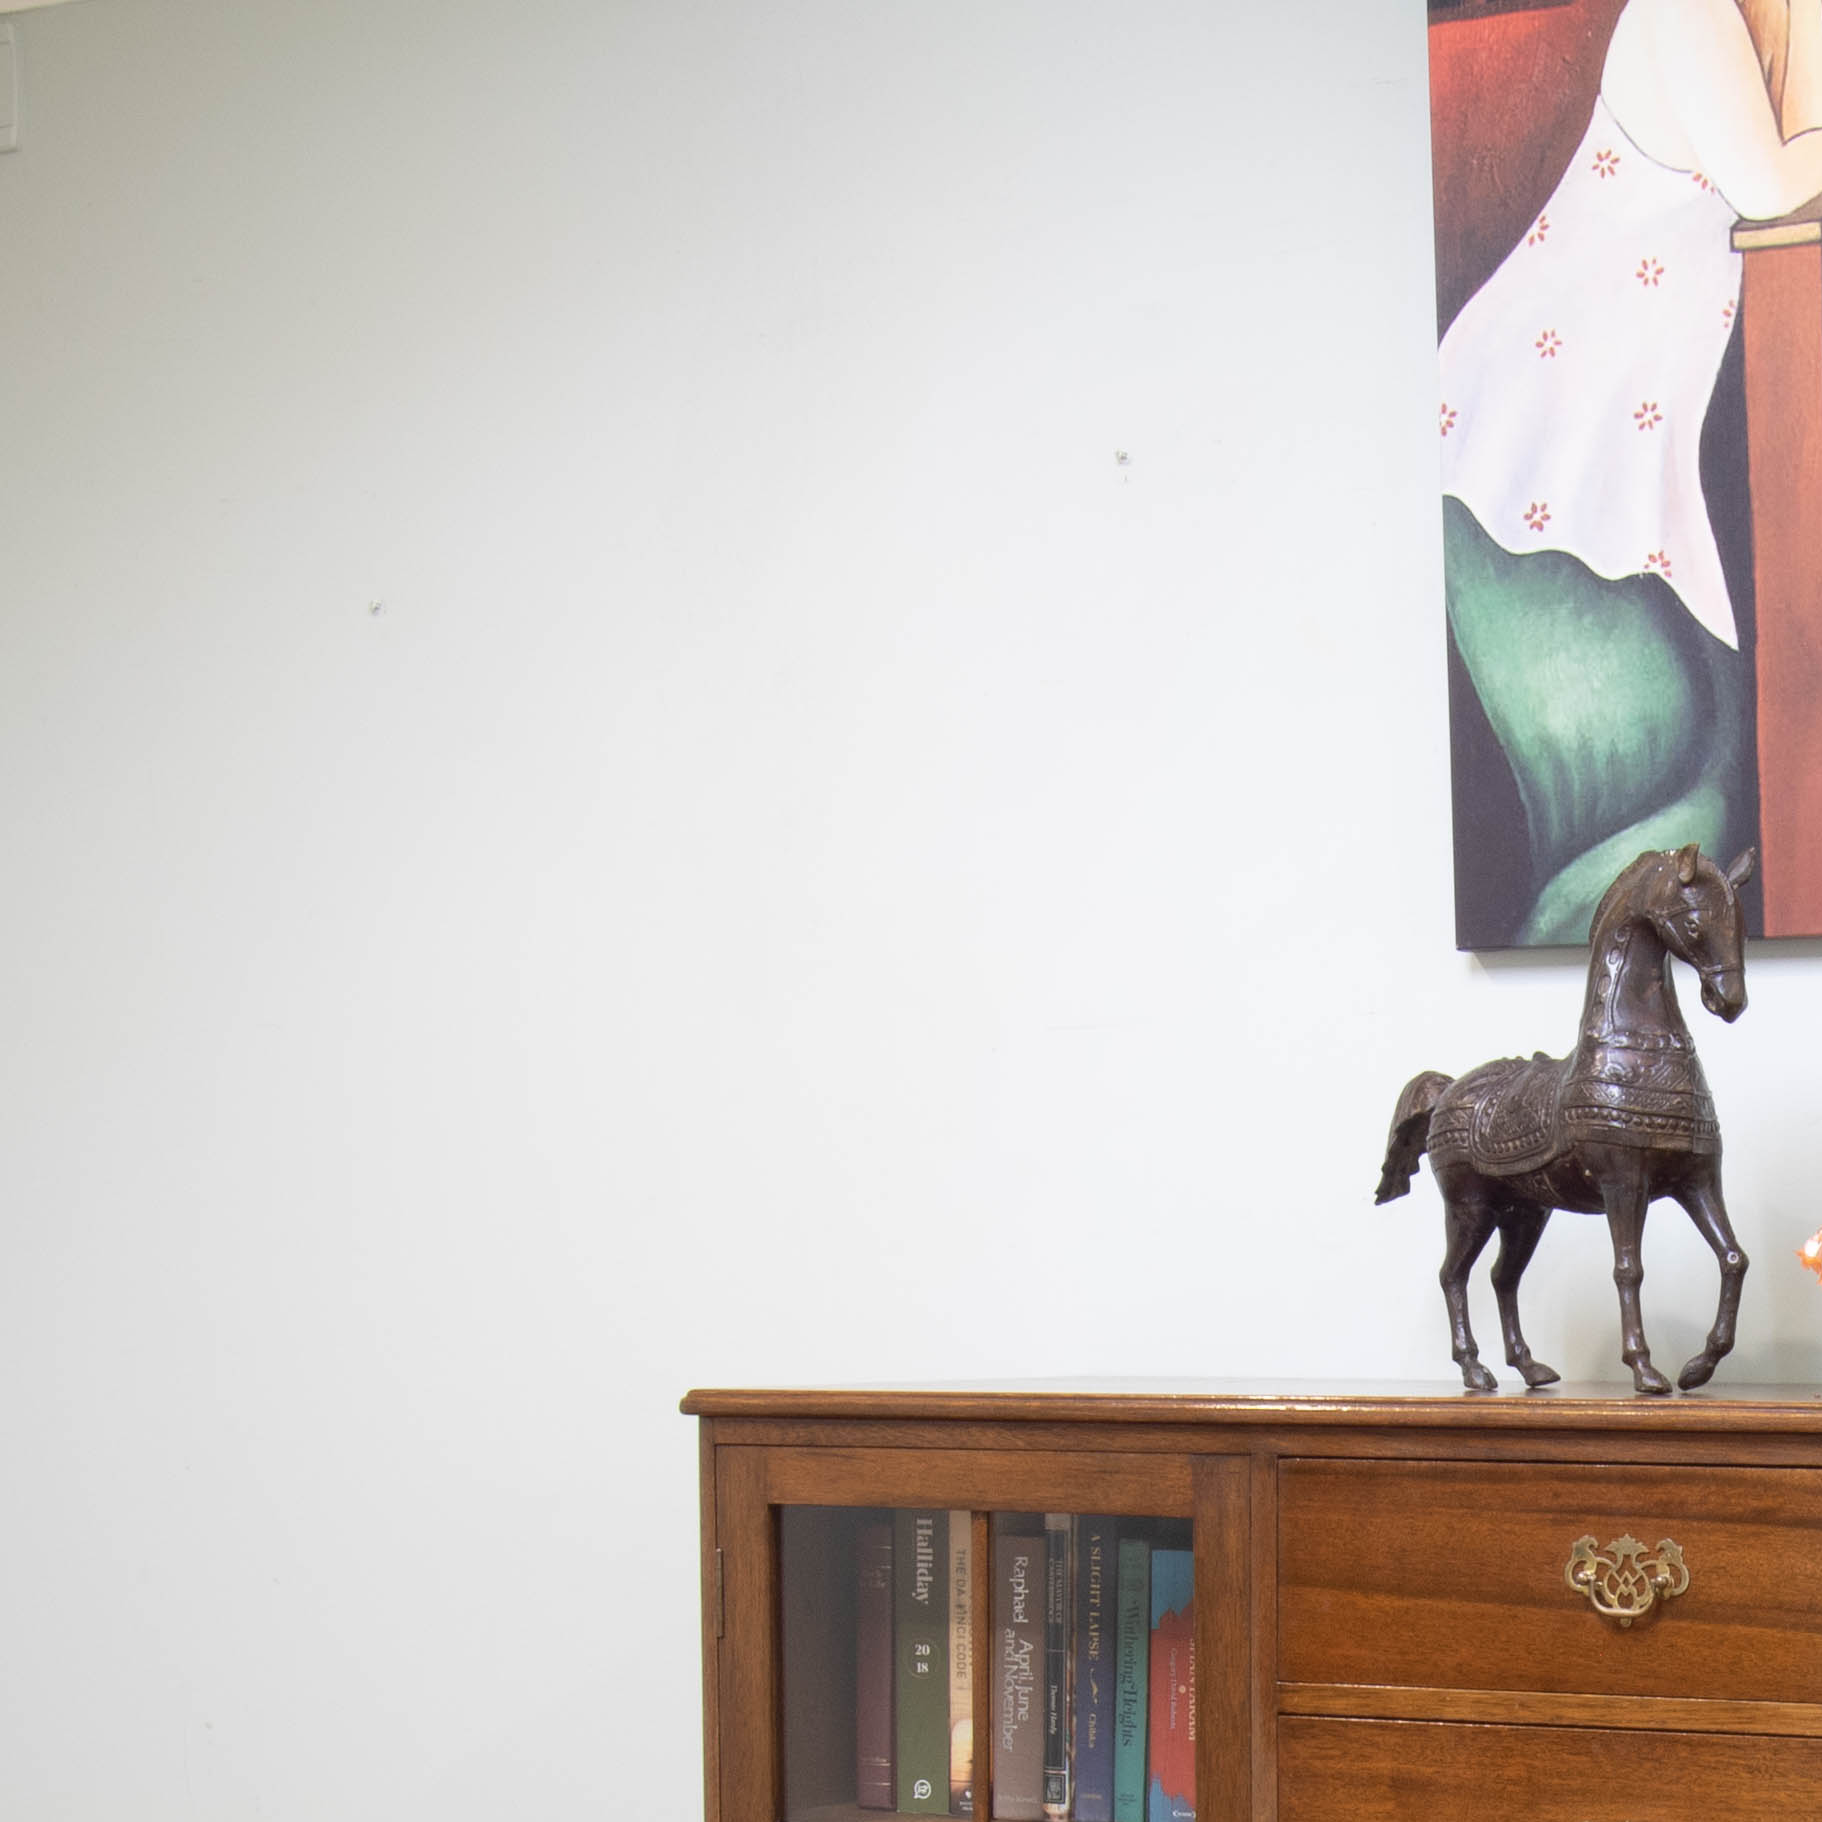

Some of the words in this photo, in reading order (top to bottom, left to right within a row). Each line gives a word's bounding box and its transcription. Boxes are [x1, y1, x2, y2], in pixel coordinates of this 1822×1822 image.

[912, 1518, 933, 1604] Halliday
[955, 1550, 967, 1576] THE
[1088, 1546, 1101, 1607] SLIGHT
[1009, 1556, 1029, 1624] Raphael
[914, 1644, 931, 1656] 20
[1004, 1628, 1018, 1661] and
[1087, 1611, 1099, 1661] LAPSE
[1119, 1600, 1139, 1683] Wuthering
[916, 1662, 929, 1673] 18
[956, 1644, 968, 1679] CODE
[1001, 1664, 1018, 1752] November
[1017, 1684, 1033, 1721] June
[1118, 1684, 1139, 1747] Heights
